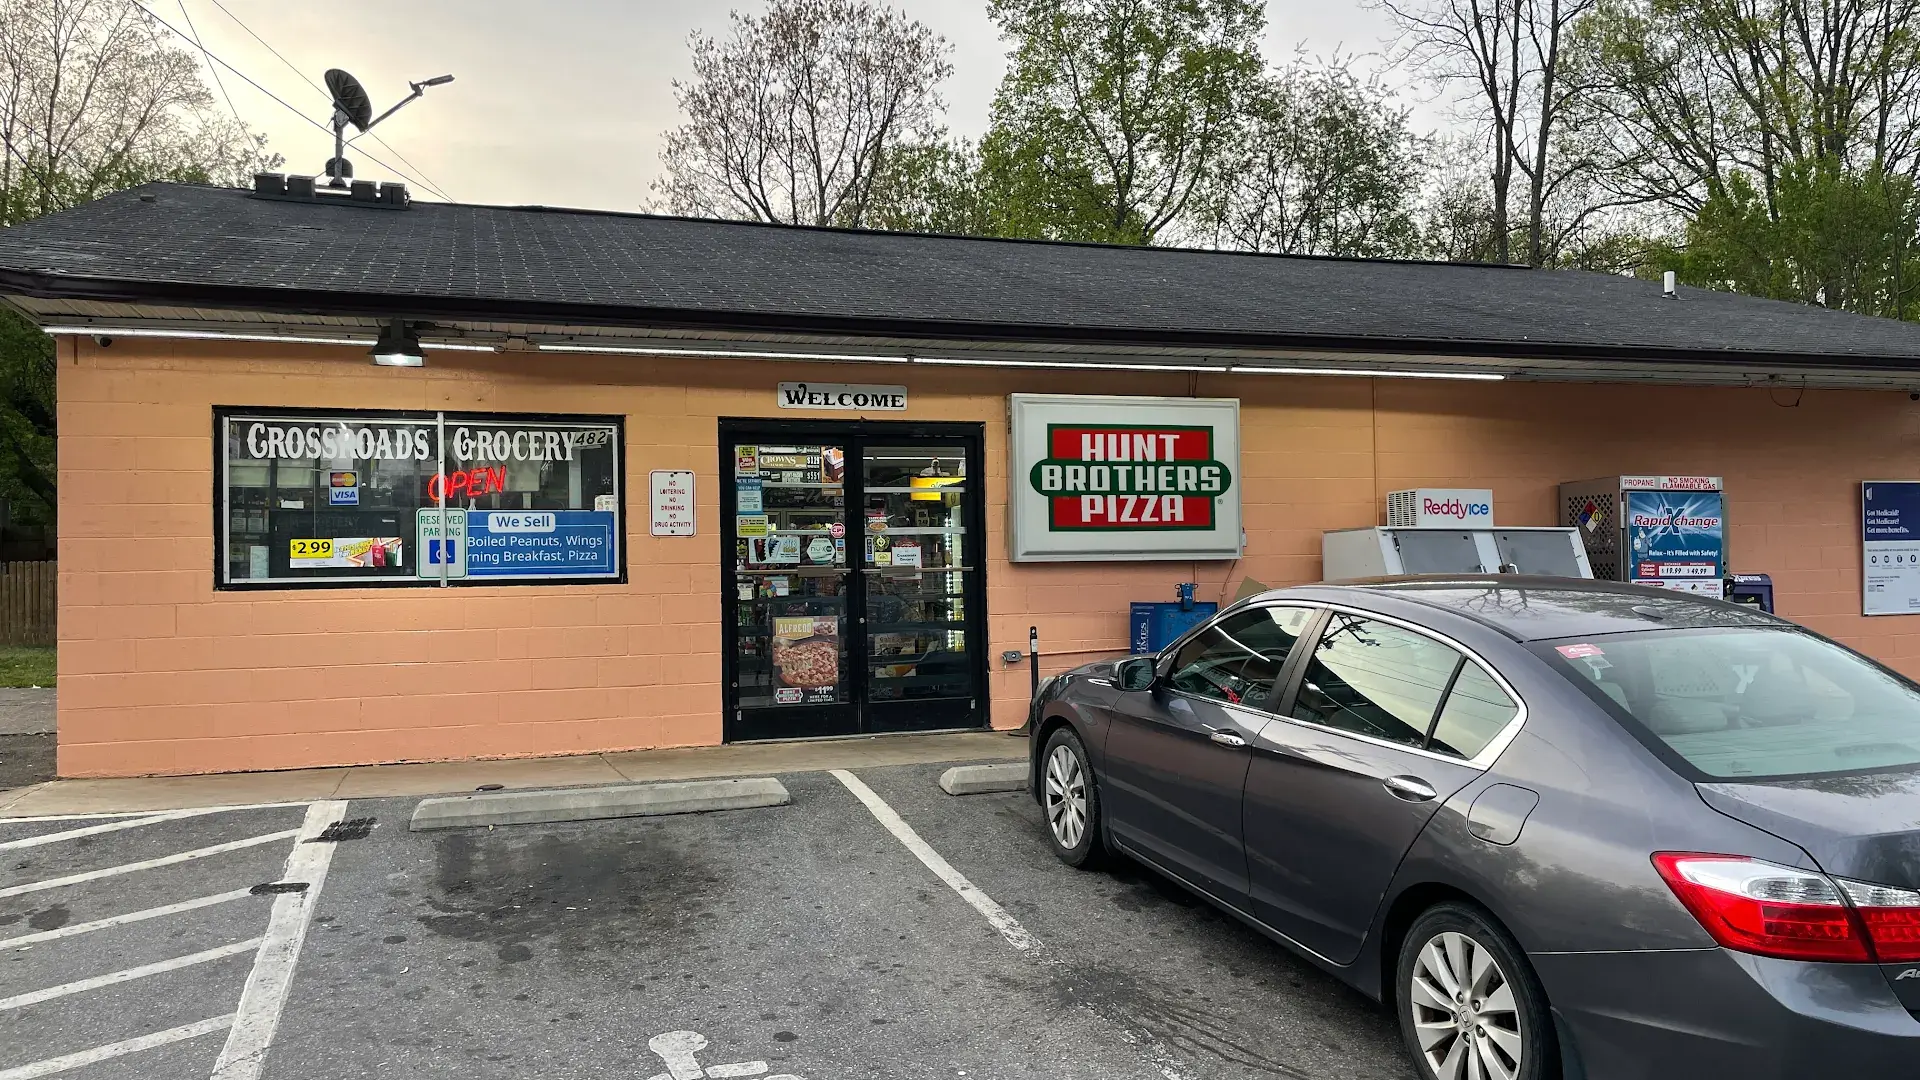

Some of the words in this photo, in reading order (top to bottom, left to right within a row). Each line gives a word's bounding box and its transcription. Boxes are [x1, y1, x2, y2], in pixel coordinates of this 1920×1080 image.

[785, 383, 904, 408] WELCOME
[247, 423, 429, 460] CROSSROADS
[453, 427, 575, 461] GROCERY
[576, 431, 607, 445] 482
[1082, 433, 1180, 461] HUNT
[760, 455, 797, 465] CROWNS
[428, 465, 506, 501] OPEN
[1041, 465, 1220, 491] BROTHERS
[1624, 479, 1654, 487] PROPANE
[334, 491, 356, 499] VISA
[1081, 495, 1184, 522] PIZZA
[420, 515, 464, 524] RESEVED
[496, 516, 520, 527] We
[524, 515, 550, 527] Sell
[1594, 511, 1600, 522] 0
[423, 527, 461, 536] PARING
[467, 536, 506, 547] Boiled
[510, 536, 562, 549] Peanuts,
[565, 535, 603, 549] Wings
[467, 552, 500, 564] rning
[503, 551, 565, 562] Breakfast,
[568, 550, 598, 560] Pizza
[1701, 549, 1718, 557] Safety!
[779, 623, 811, 634] ALFREDO
[1895, 968, 1920, 980] A
